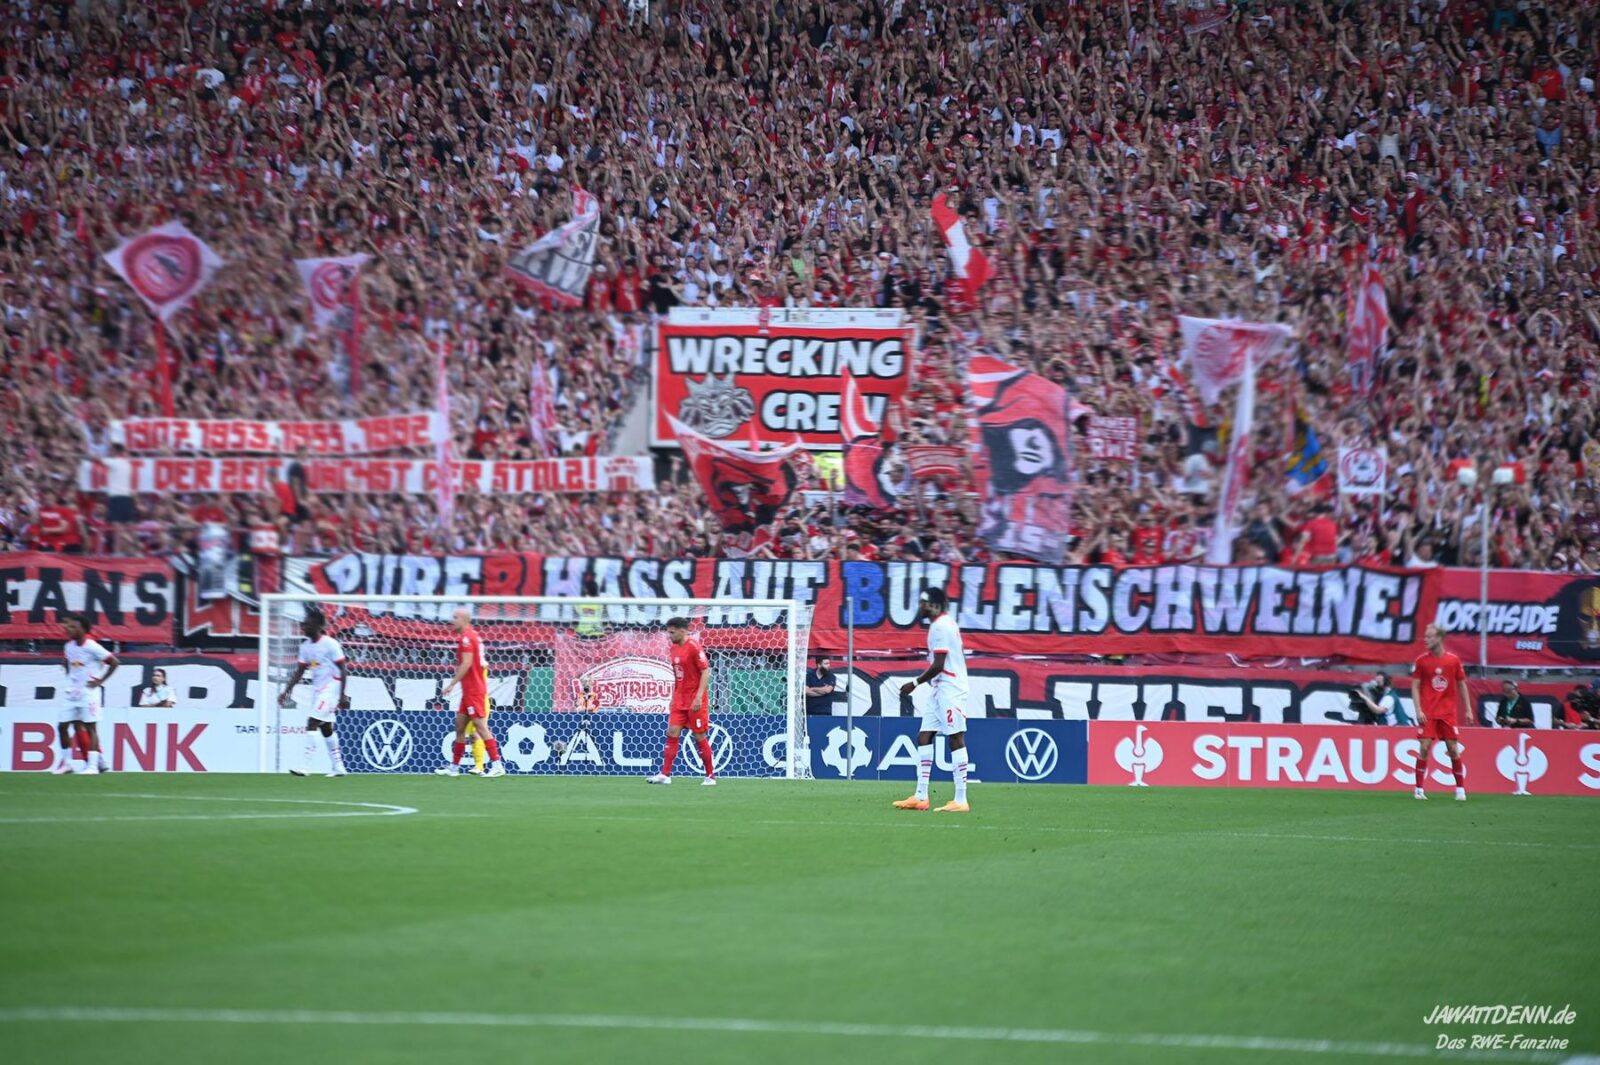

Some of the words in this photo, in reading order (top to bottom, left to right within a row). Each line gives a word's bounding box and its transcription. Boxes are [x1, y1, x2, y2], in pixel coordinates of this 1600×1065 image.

[668, 337, 903, 377] WRECKING
[491, 457, 597, 491] STOLZ!
[0, 567, 168, 626] FANS
[544, 556, 693, 625] HASS
[709, 560, 827, 625] AUF
[841, 561, 1422, 642] BULLENSCHWEINE!
[947, 709, 953, 723] 2
[1192, 734, 1467, 786] STRAUSS
